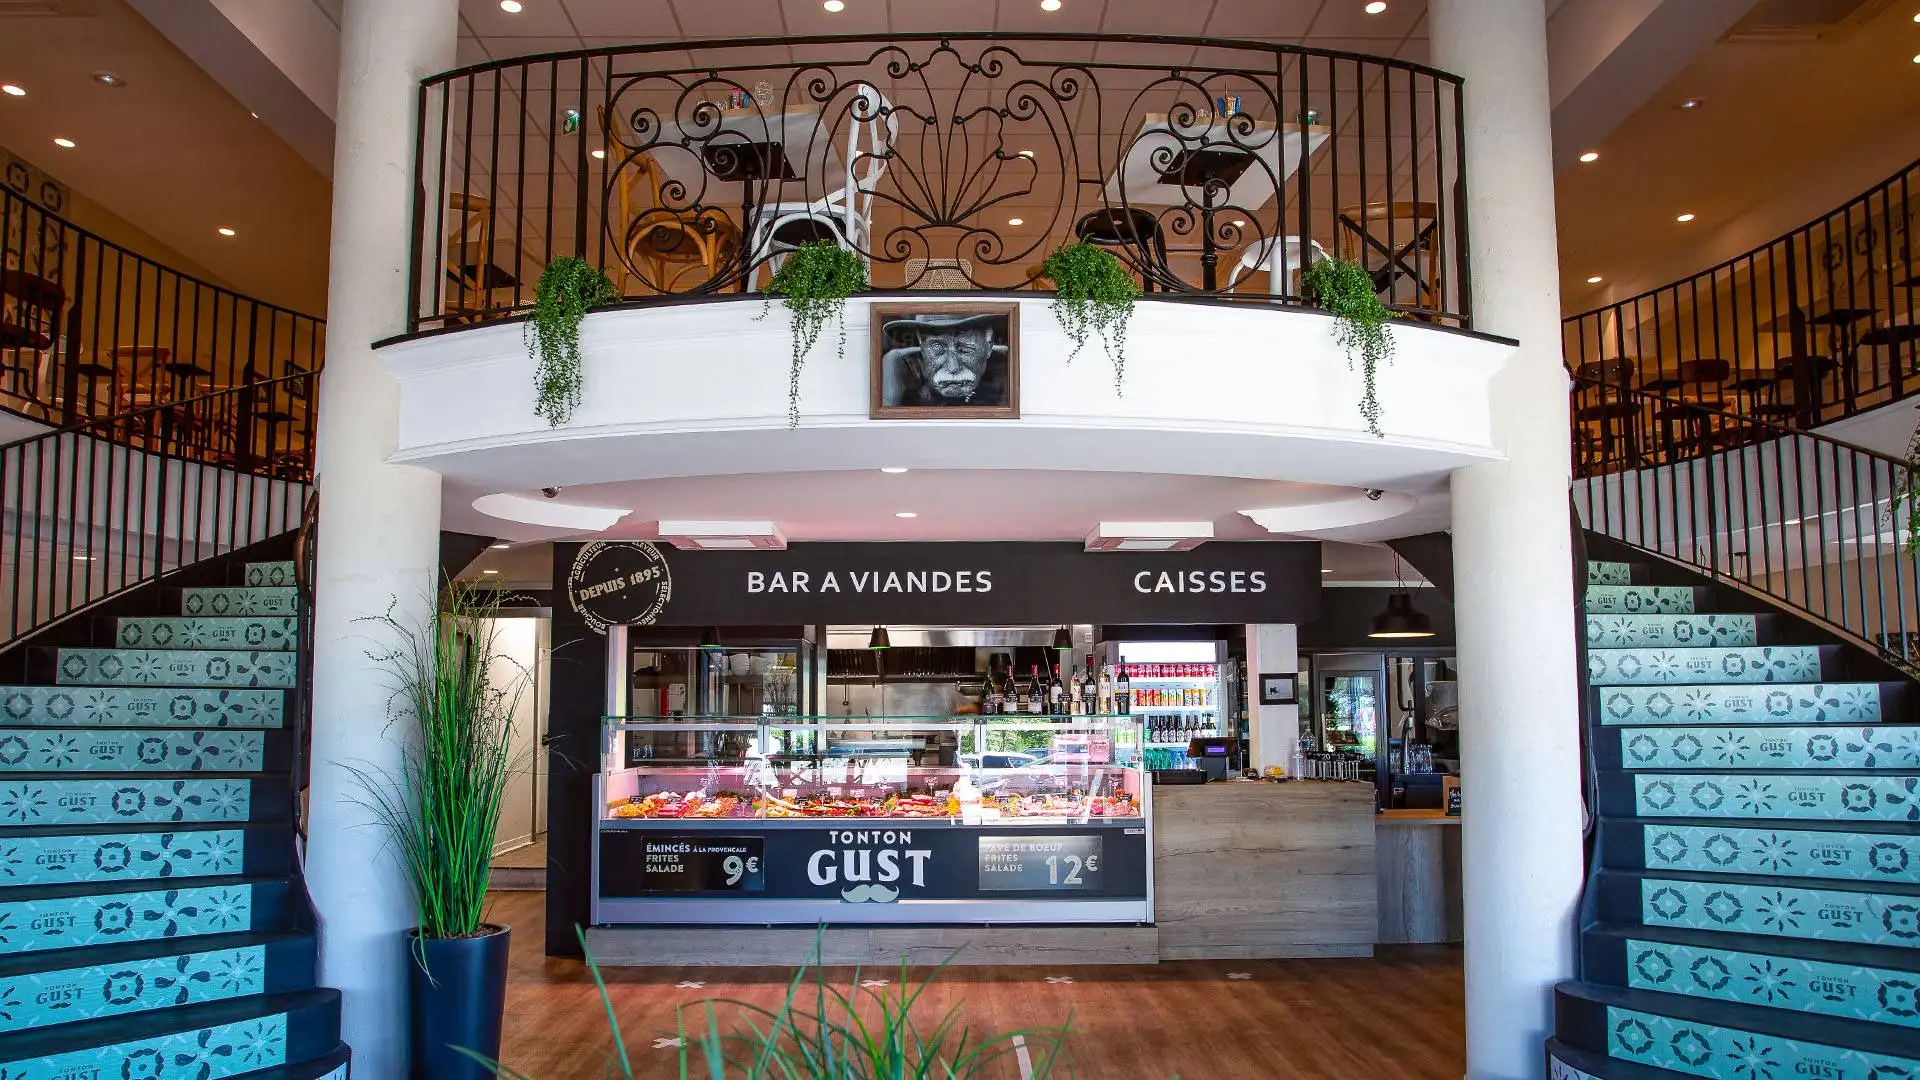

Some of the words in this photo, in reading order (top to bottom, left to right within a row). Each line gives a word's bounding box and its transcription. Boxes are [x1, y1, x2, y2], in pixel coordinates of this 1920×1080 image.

[573, 541, 607, 580] AGRICULTEUR
[579, 577, 626, 601] DEPUIS
[629, 565, 661, 586] 1895
[747, 571, 810, 593] BAR
[820, 571, 842, 593] A
[849, 571, 993, 593] VIANDES
[1133, 571, 1268, 593] CAISSES
[263, 598, 283, 607] GUST
[1597, 597, 1617, 606] GUST
[577, 603, 606, 630] BOUCHER
[212, 629, 235, 638] GUST
[1642, 627, 1665, 635] GUST
[169, 663, 196, 672] GUST
[1687, 661, 1712, 670] GUST
[128, 702, 158, 711] GUST
[1724, 699, 1754, 708] GUST
[90, 745, 125, 755] GUST
[1759, 742, 1793, 752] GUST
[58, 796, 97, 807] GUST
[1788, 791, 1826, 802] GUST
[829, 830, 912, 845] TONTON
[35, 853, 78, 865] GUST
[646, 854, 680, 863] FRITES
[984, 854, 1018, 863] FRITES
[1809, 848, 1852, 861] GUST
[646, 864, 684, 873] SALADE
[723, 855, 759, 886] 9€
[807, 849, 932, 887] GUST
[984, 864, 1023, 873] SALADE
[1045, 855, 1098, 885] 12€
[1818, 909, 1864, 923] GUST
[31, 915, 77, 931] GUST
[1808, 980, 1857, 997] GUST
[36, 987, 84, 1005] GUST
[1794, 1062, 1846, 1080] GUST
